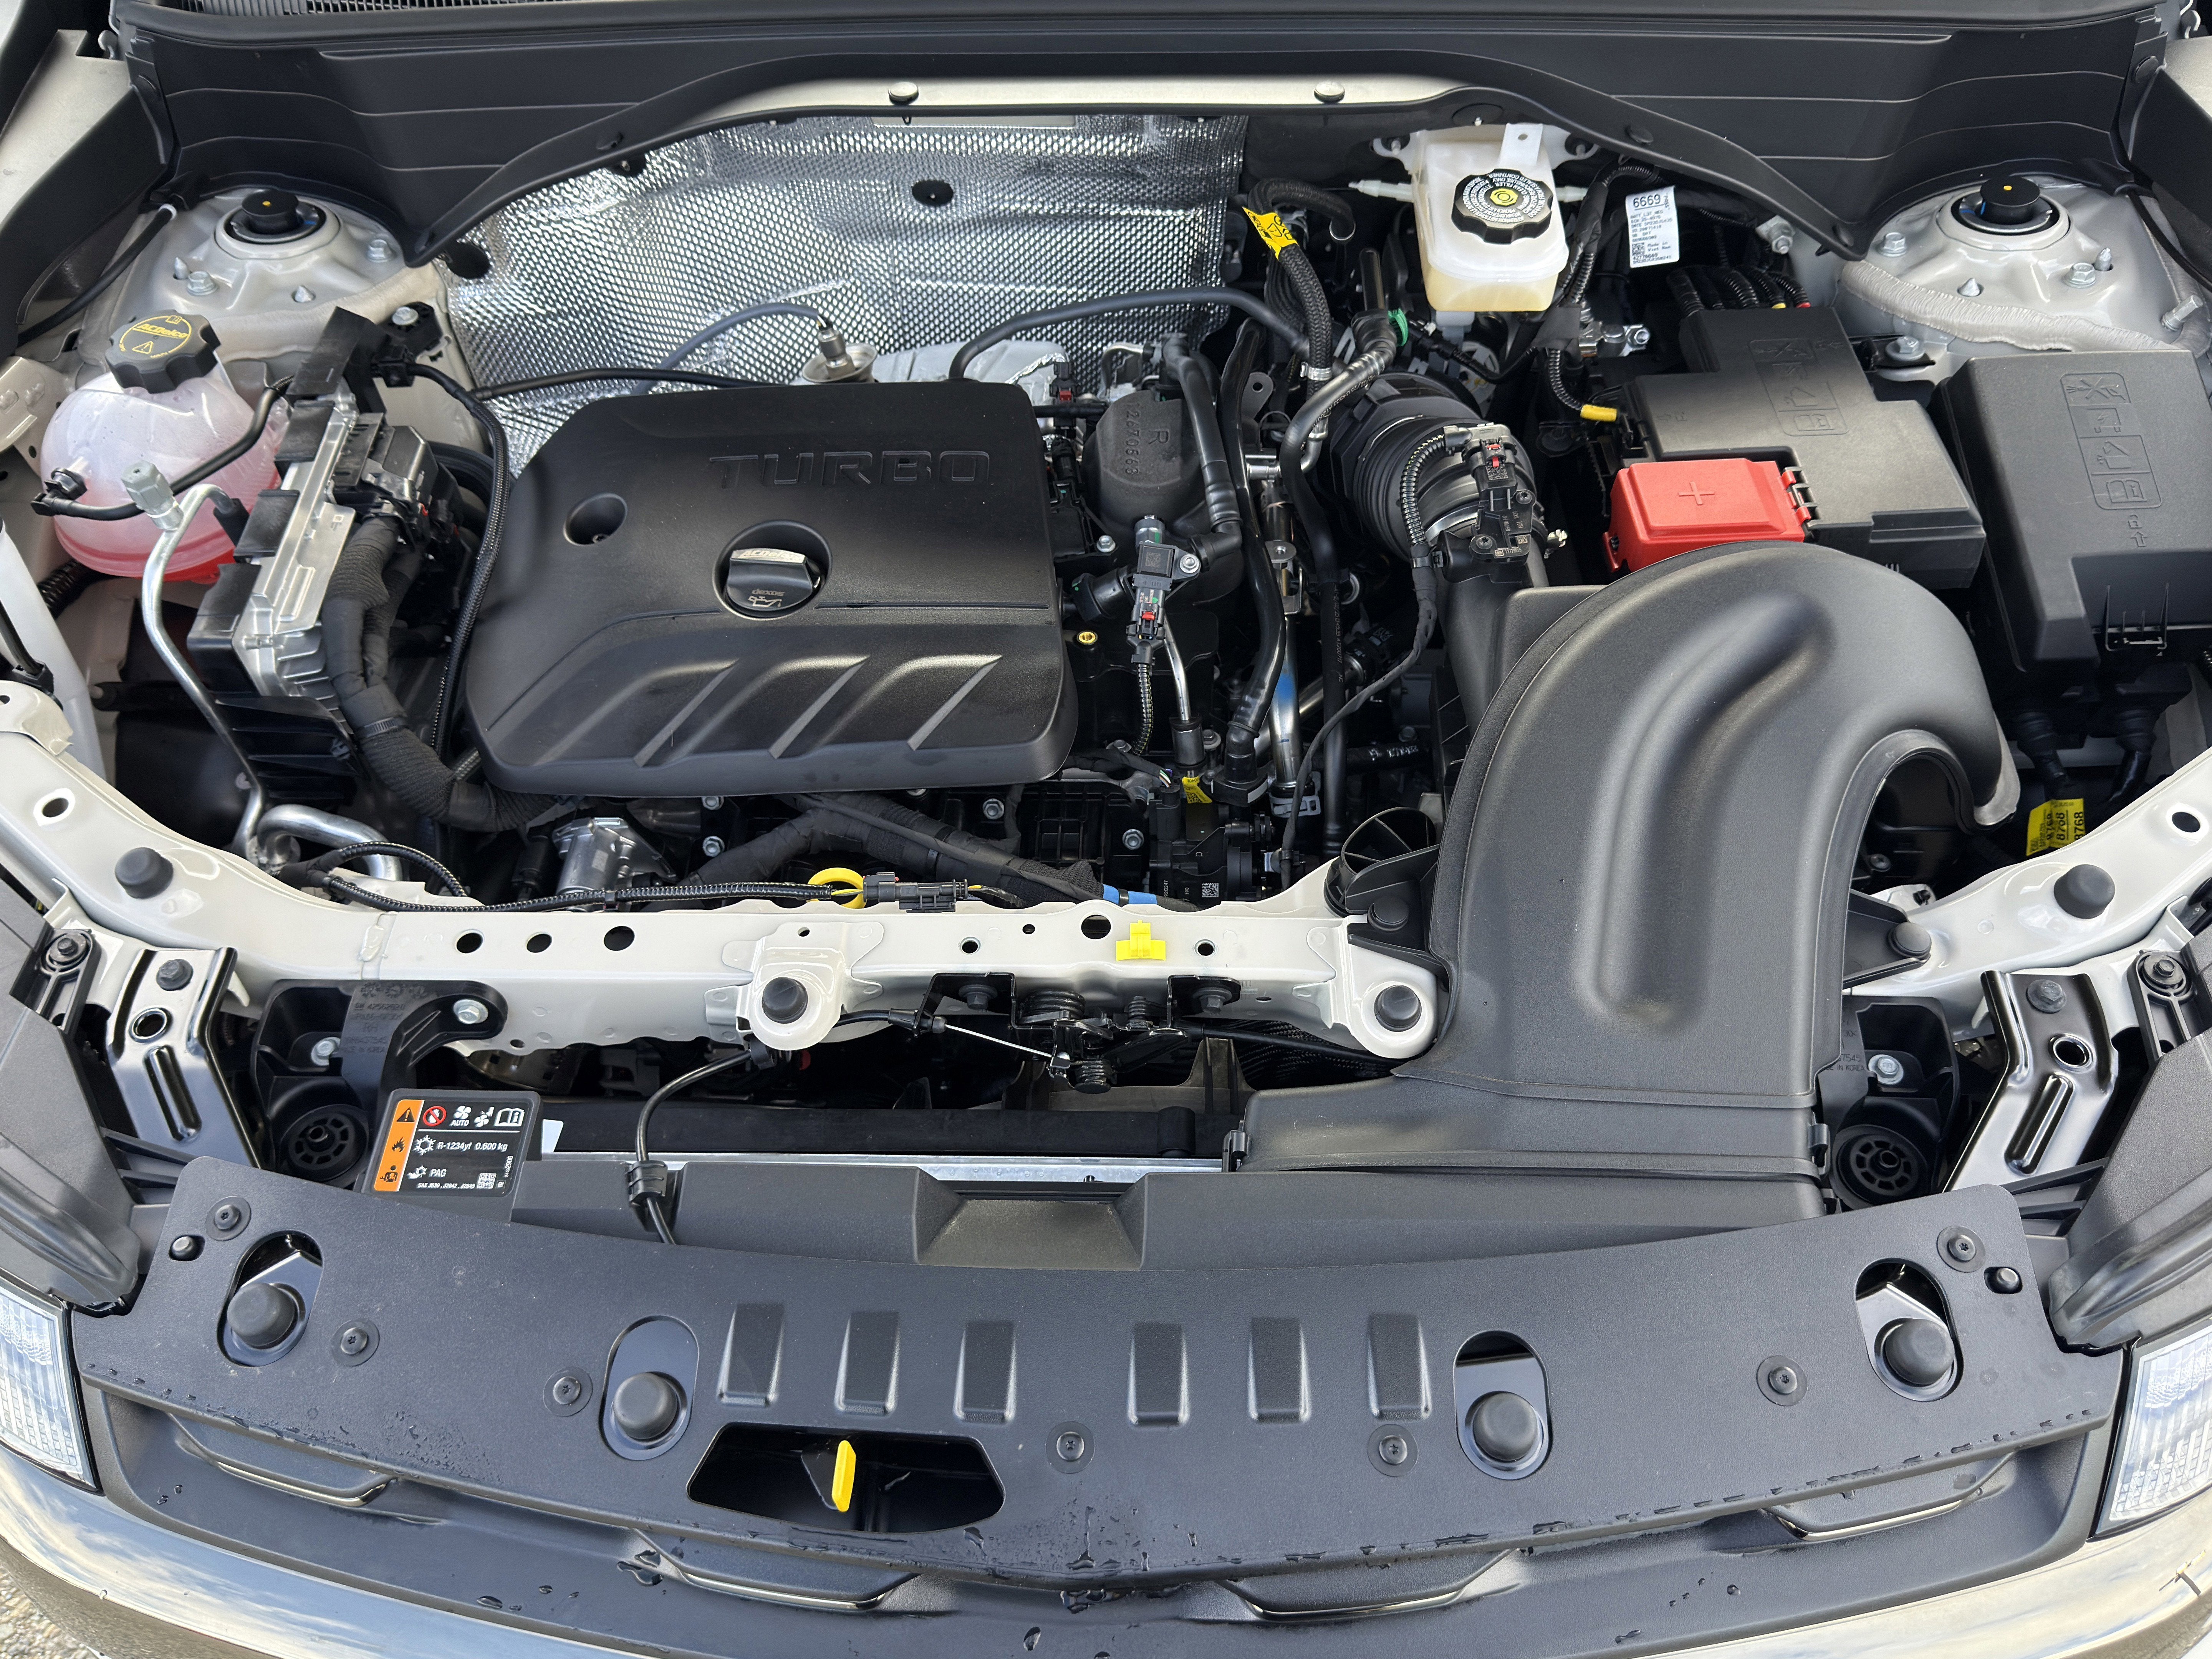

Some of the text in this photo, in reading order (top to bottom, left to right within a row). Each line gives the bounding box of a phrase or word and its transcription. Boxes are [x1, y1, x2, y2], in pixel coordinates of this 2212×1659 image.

[1633, 194, 1661, 208] 6669
[137, 323, 188, 338] ACDelco
[1148, 428, 1169, 446] R
[709, 450, 990, 489] TURBO
[2074, 811, 2084, 841] 8768
[437, 1142, 508, 1152] R-1234yf 0.600 kg
[430, 1169, 447, 1177] PAG
